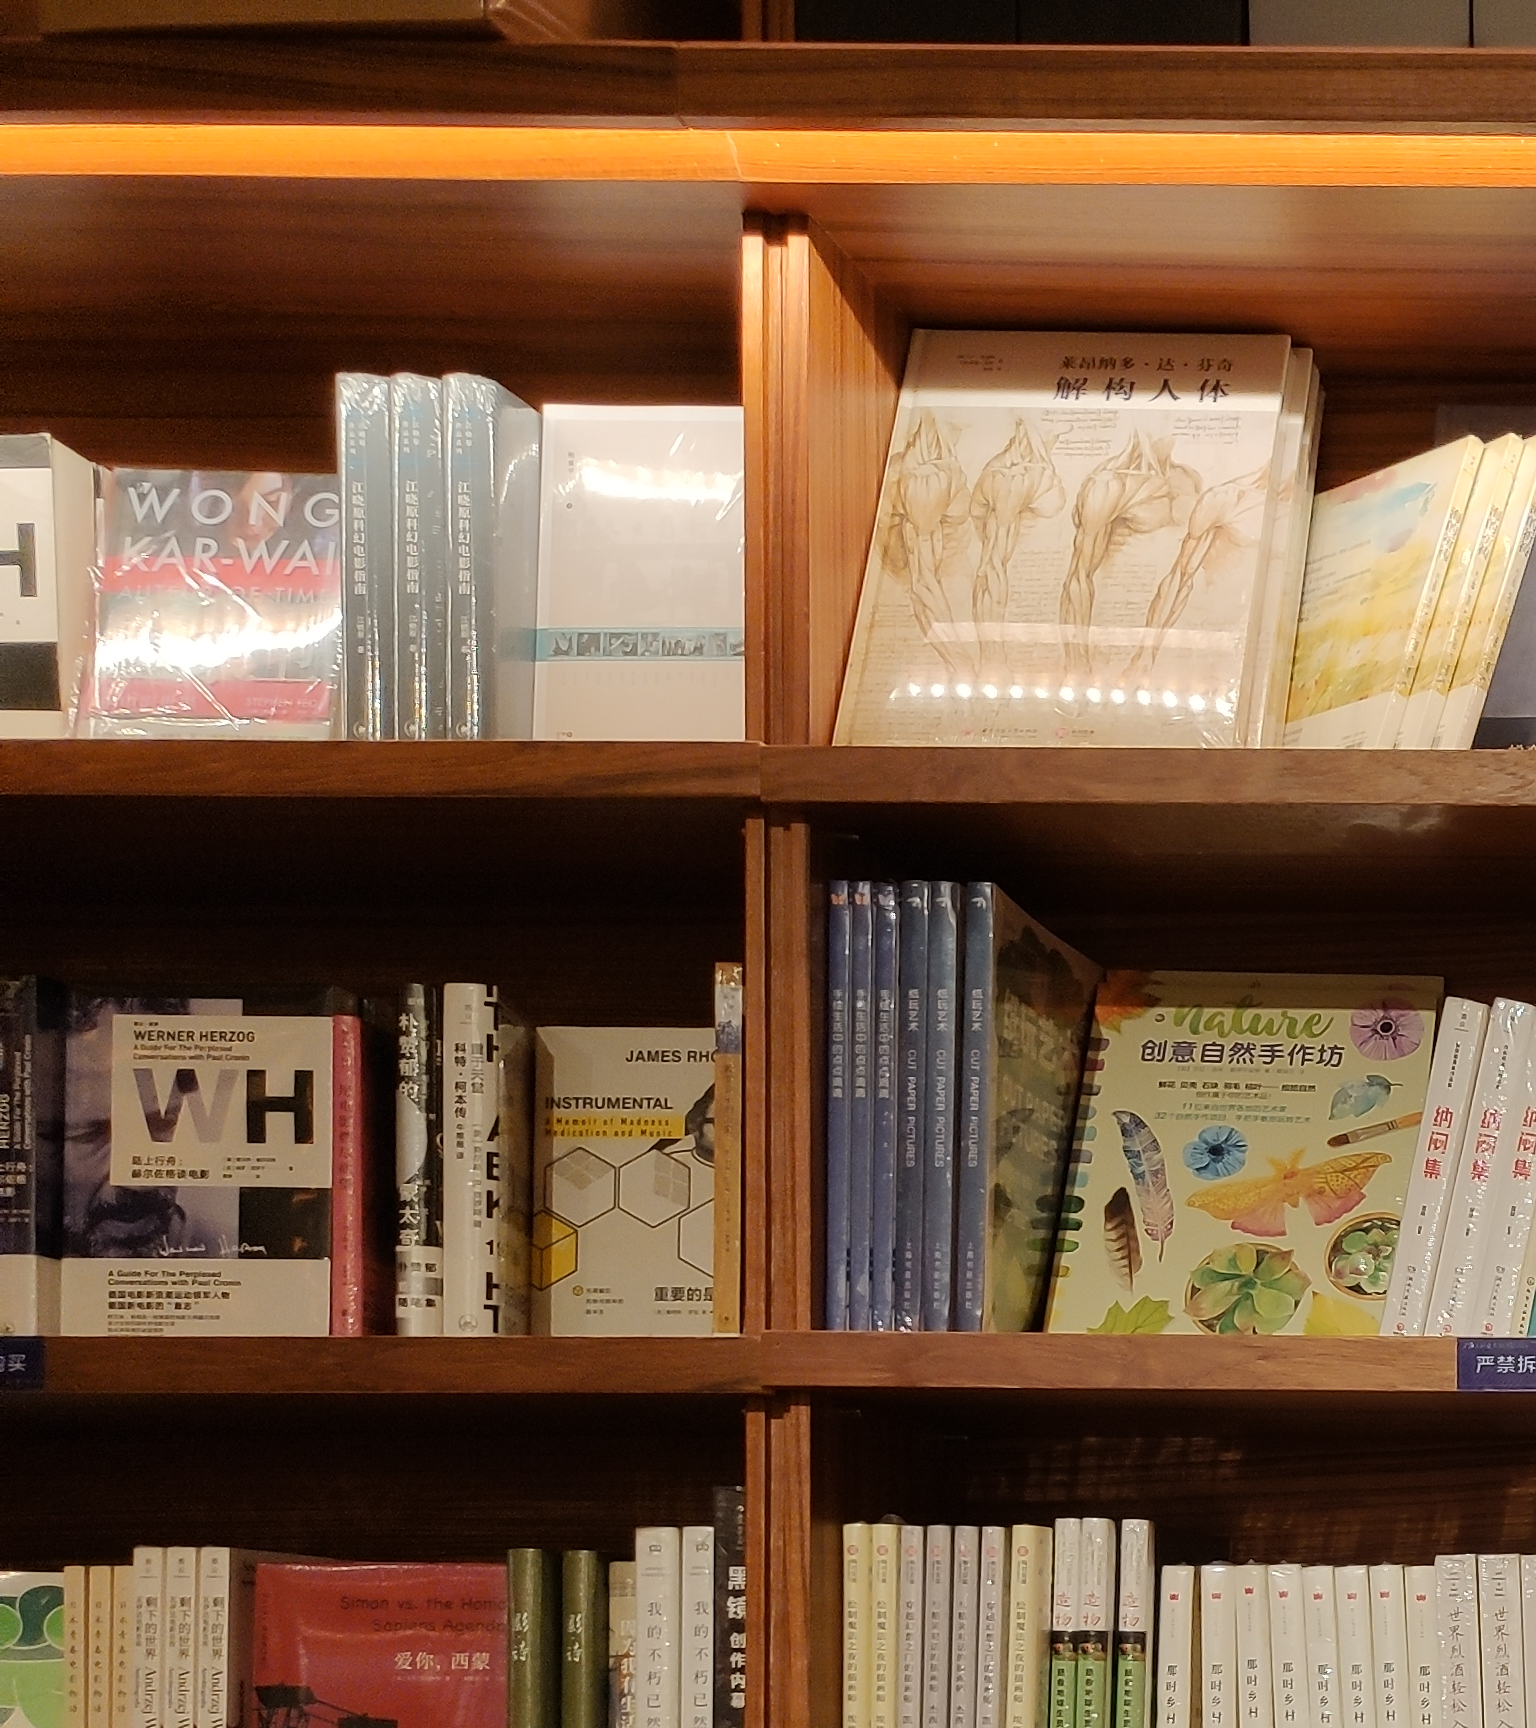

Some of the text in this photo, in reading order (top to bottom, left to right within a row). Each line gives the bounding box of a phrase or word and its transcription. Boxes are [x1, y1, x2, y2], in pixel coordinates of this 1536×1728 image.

[1052, 376, 1231, 403] 解构人体
[1059, 355, 1233, 371] 莱昂纳多·达·芬奇
[127, 480, 341, 527] WONG
[121, 536, 338, 575] KAR-WAI
[351, 480, 368, 597] 江晓原科幻电影指南
[404, 480, 420, 597] 江晓原科幻电影指南
[133, 1030, 255, 1043] WERNER HERZOG
[1140, 1041, 1346, 1069] 创意自然手作坊
[545, 1097, 673, 1111] INSTRUMENTAL
[906, 1050, 918, 1168] CUT PAPER PICTURES
[934, 1050, 947, 1168] CUT PAPER PICTURES
[1422, 1105, 1454, 1180] 纳闷集
[1470, 1106, 1502, 1182] 纳闷集
[394, 1651, 491, 1672] 爱你，西蒙
[1166, 1663, 1178, 1725] 那时乡村
[1210, 1663, 1223, 1725] 那时乡村
